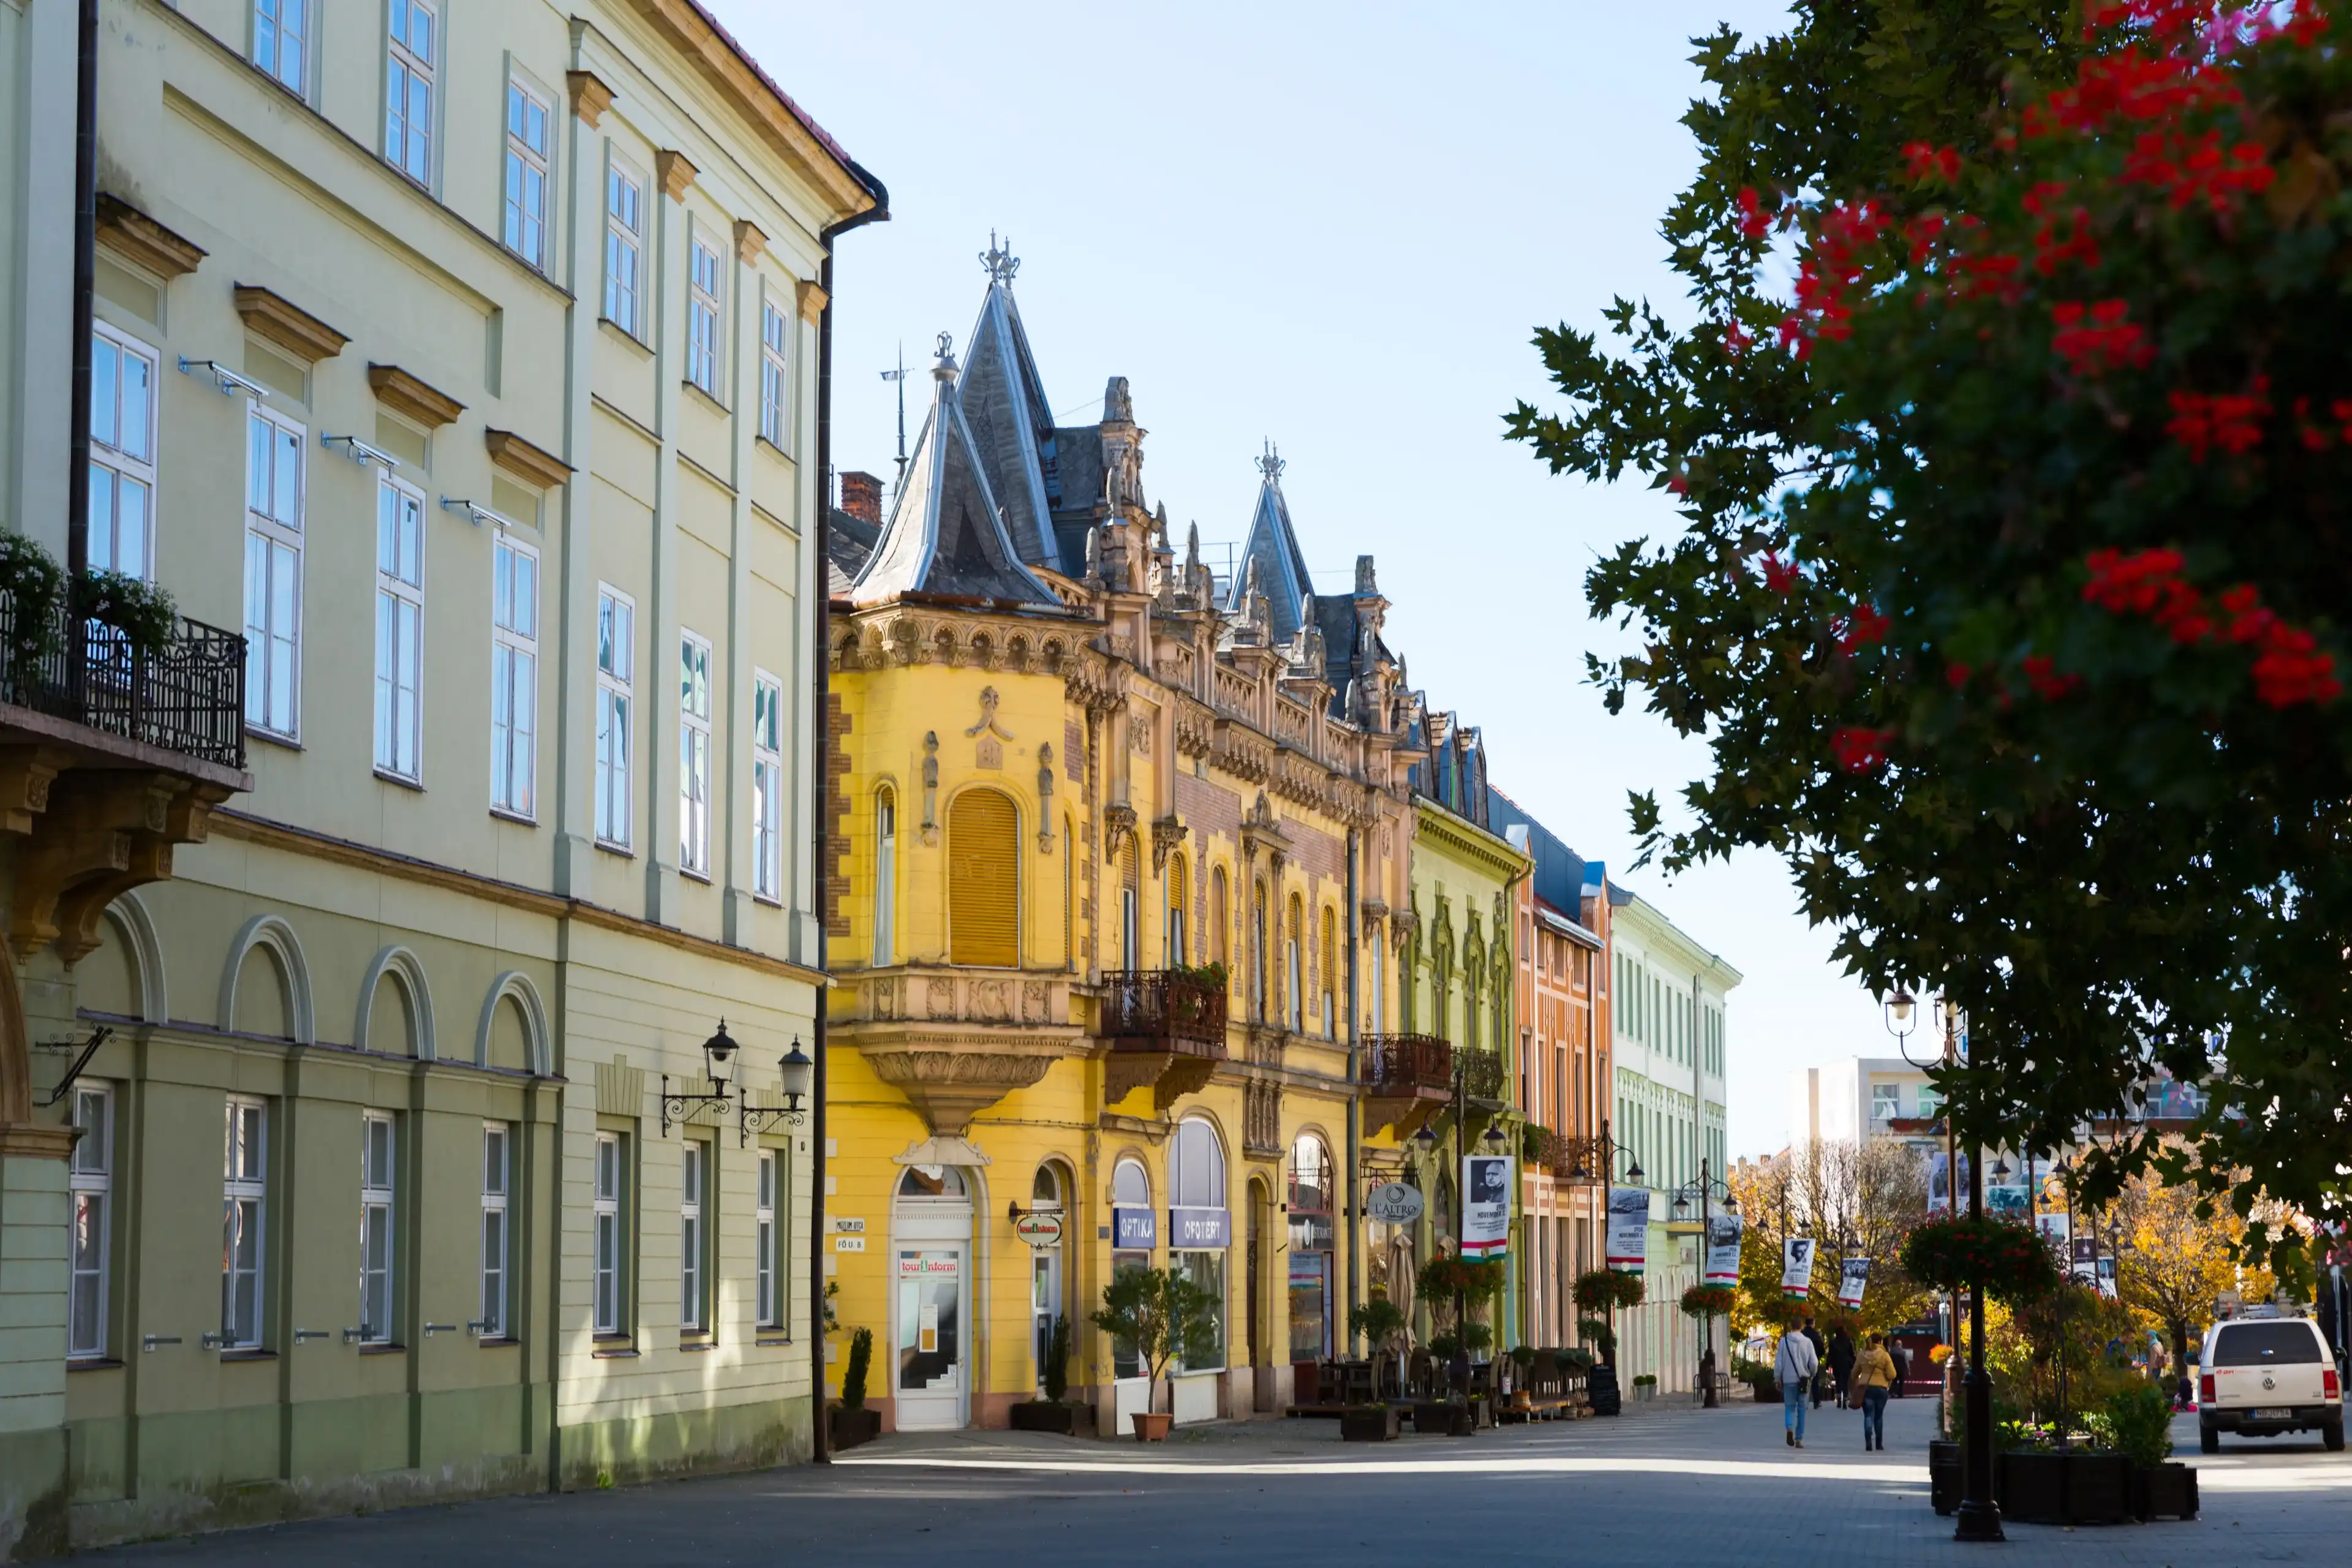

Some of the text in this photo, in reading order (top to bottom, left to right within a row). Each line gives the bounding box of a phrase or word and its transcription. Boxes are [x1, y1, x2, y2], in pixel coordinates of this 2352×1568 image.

[1121, 1218, 1153, 1238] OPTIKA
[1185, 1216, 1221, 1240] OFOTÉRT
[902, 1261, 956, 1272] tourinform
